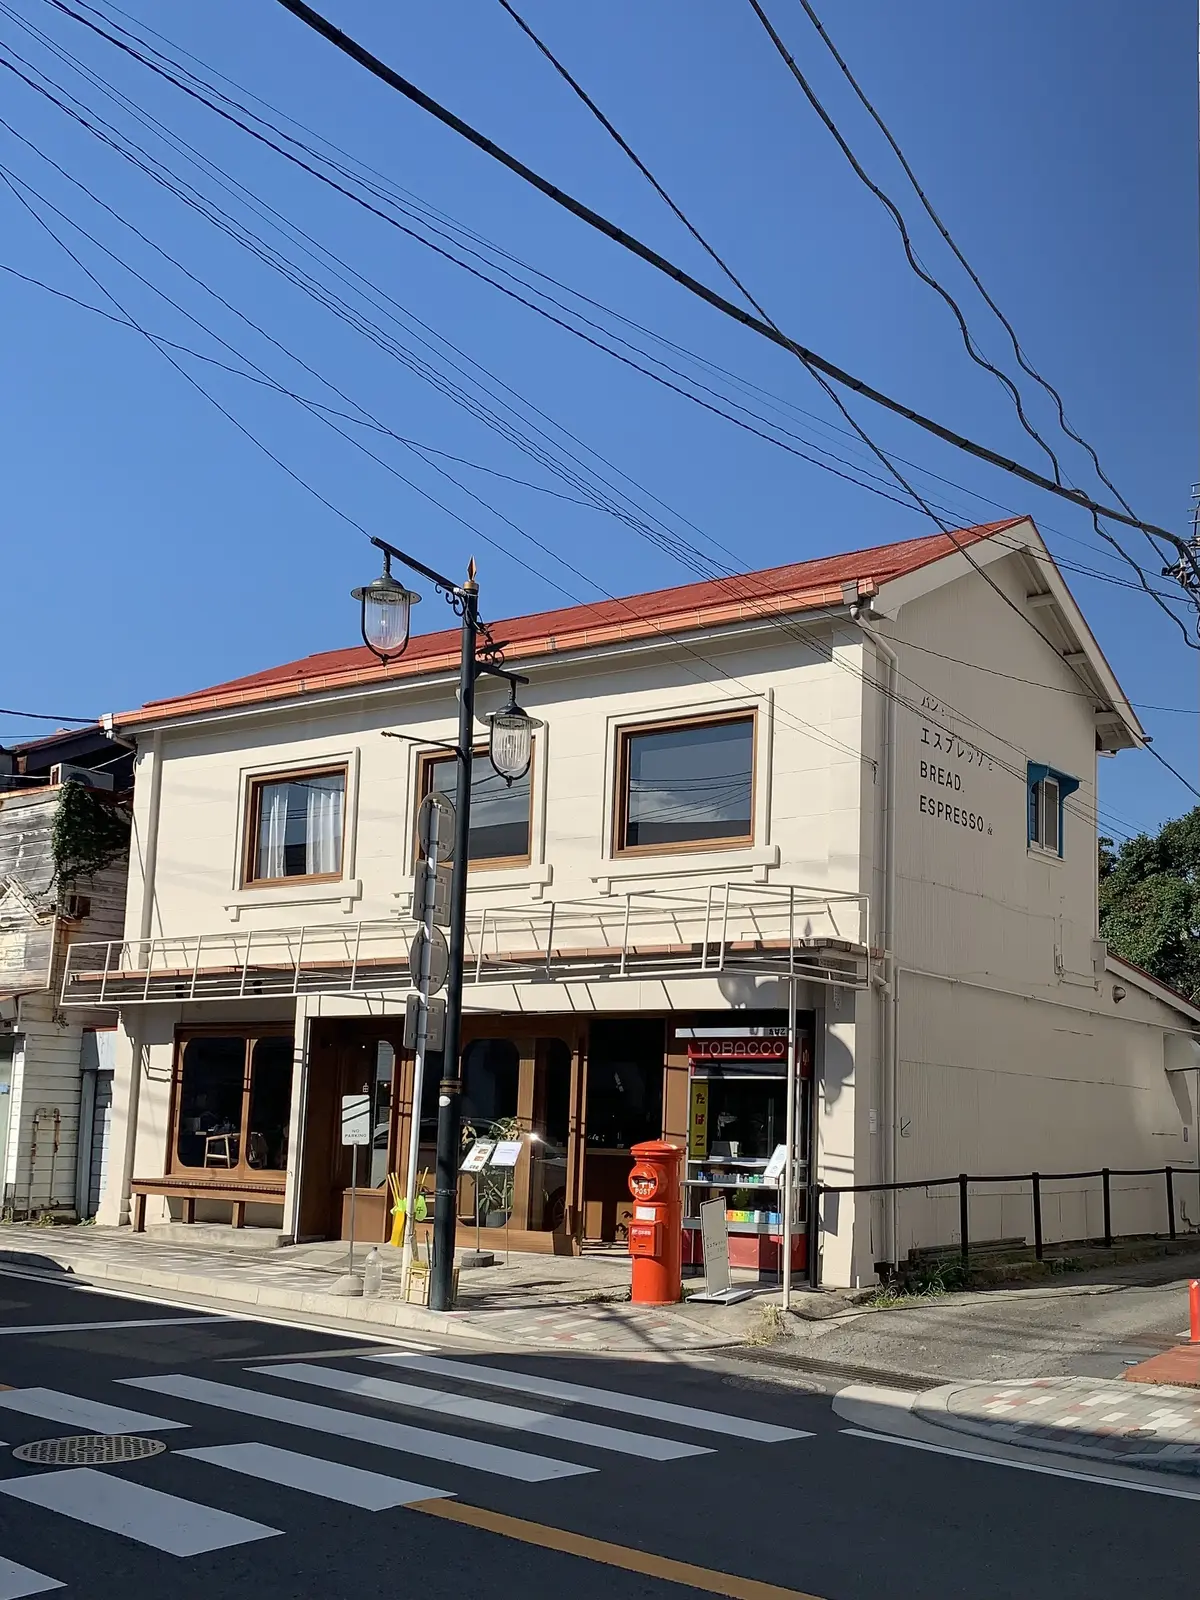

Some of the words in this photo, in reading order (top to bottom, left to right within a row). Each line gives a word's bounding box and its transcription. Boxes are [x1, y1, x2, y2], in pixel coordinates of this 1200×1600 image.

[920, 795, 984, 832] ESPRESSO
[698, 1041, 785, 1056] TOBACCO
[695, 1092, 706, 1147] たばこ
[634, 1187, 651, 1196] POST
